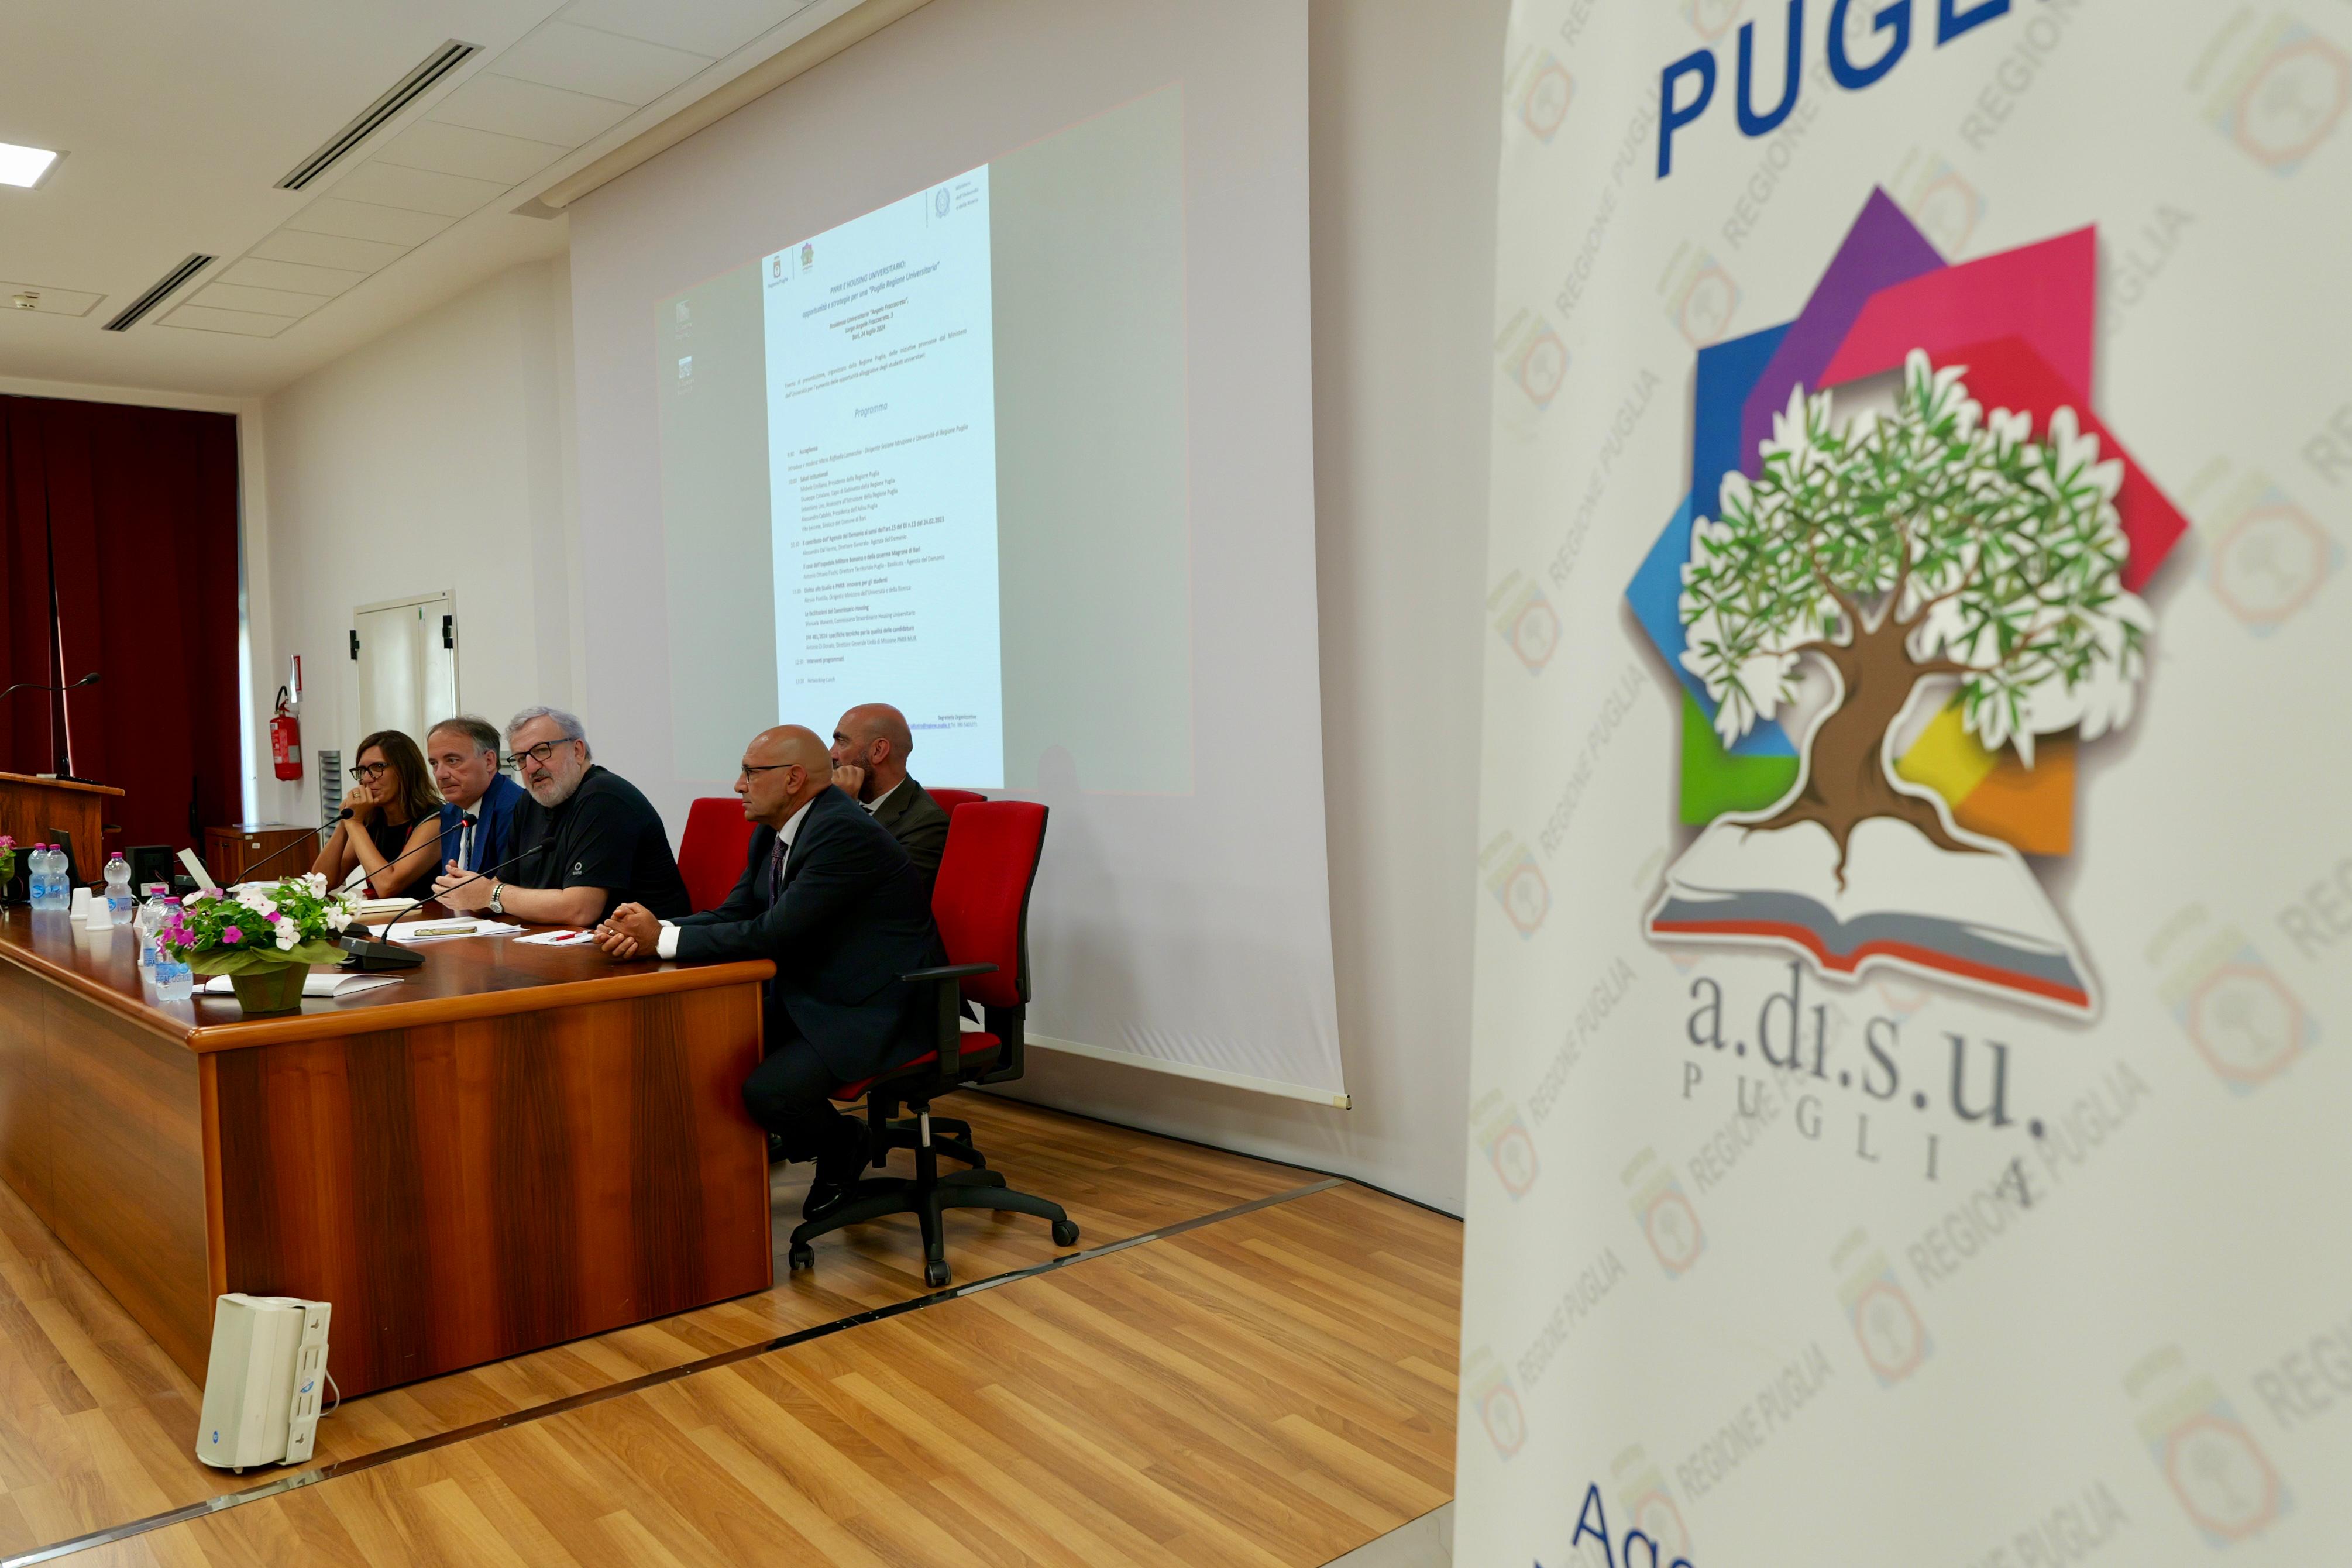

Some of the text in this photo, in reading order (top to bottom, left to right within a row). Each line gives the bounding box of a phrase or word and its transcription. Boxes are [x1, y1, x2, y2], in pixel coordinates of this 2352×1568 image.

[830, 294, 850, 308] strategie
[850, 292, 858, 302] per
[859, 288, 868, 298] una
[886, 275, 905, 288] Regione
[846, 273, 868, 288] HOUSING
[868, 260, 906, 280] UNIVERSITARIO:
[854, 402, 888, 418] Programma
[1575, 955, 1639, 1047] PUGLIA
[1563, 1245, 1628, 1328] PUGLIA
[1757, 1340, 1835, 1433] PUGLIA
